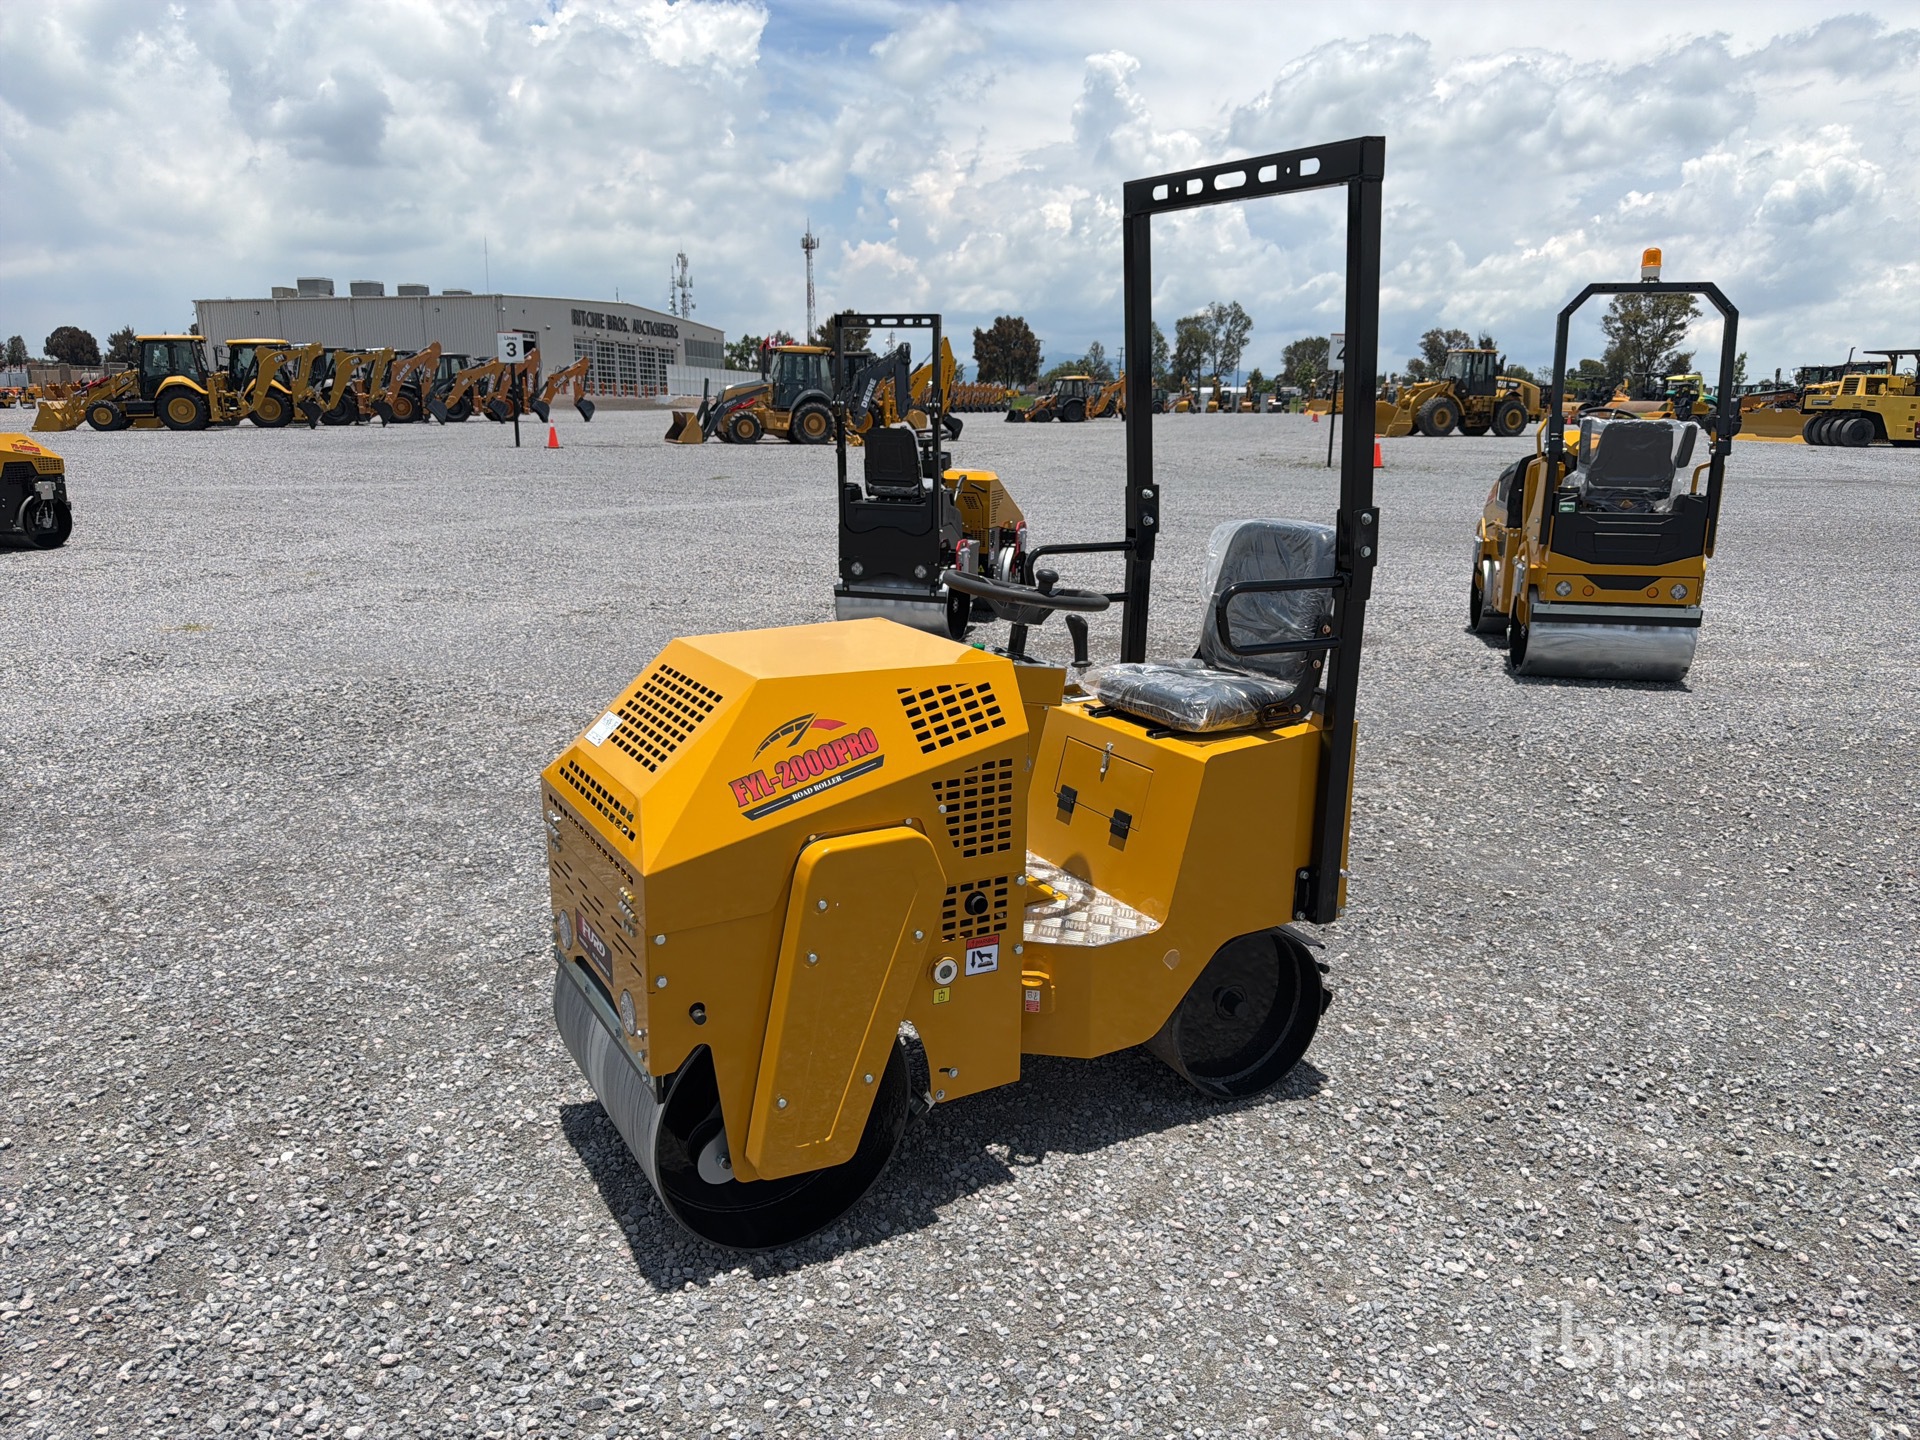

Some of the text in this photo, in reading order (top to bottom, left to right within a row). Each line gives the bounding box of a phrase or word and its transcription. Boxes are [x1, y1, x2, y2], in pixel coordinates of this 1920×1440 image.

[571, 308, 679, 339] RITCHIE BROS. AUCTIONEERS
[506, 342, 517, 357] 3
[396, 363, 411, 381] CASE
[861, 378, 877, 409] DEERE
[728, 727, 879, 807] FYL-2000PRO
[791, 775, 843, 801] ROAD ROLLER
